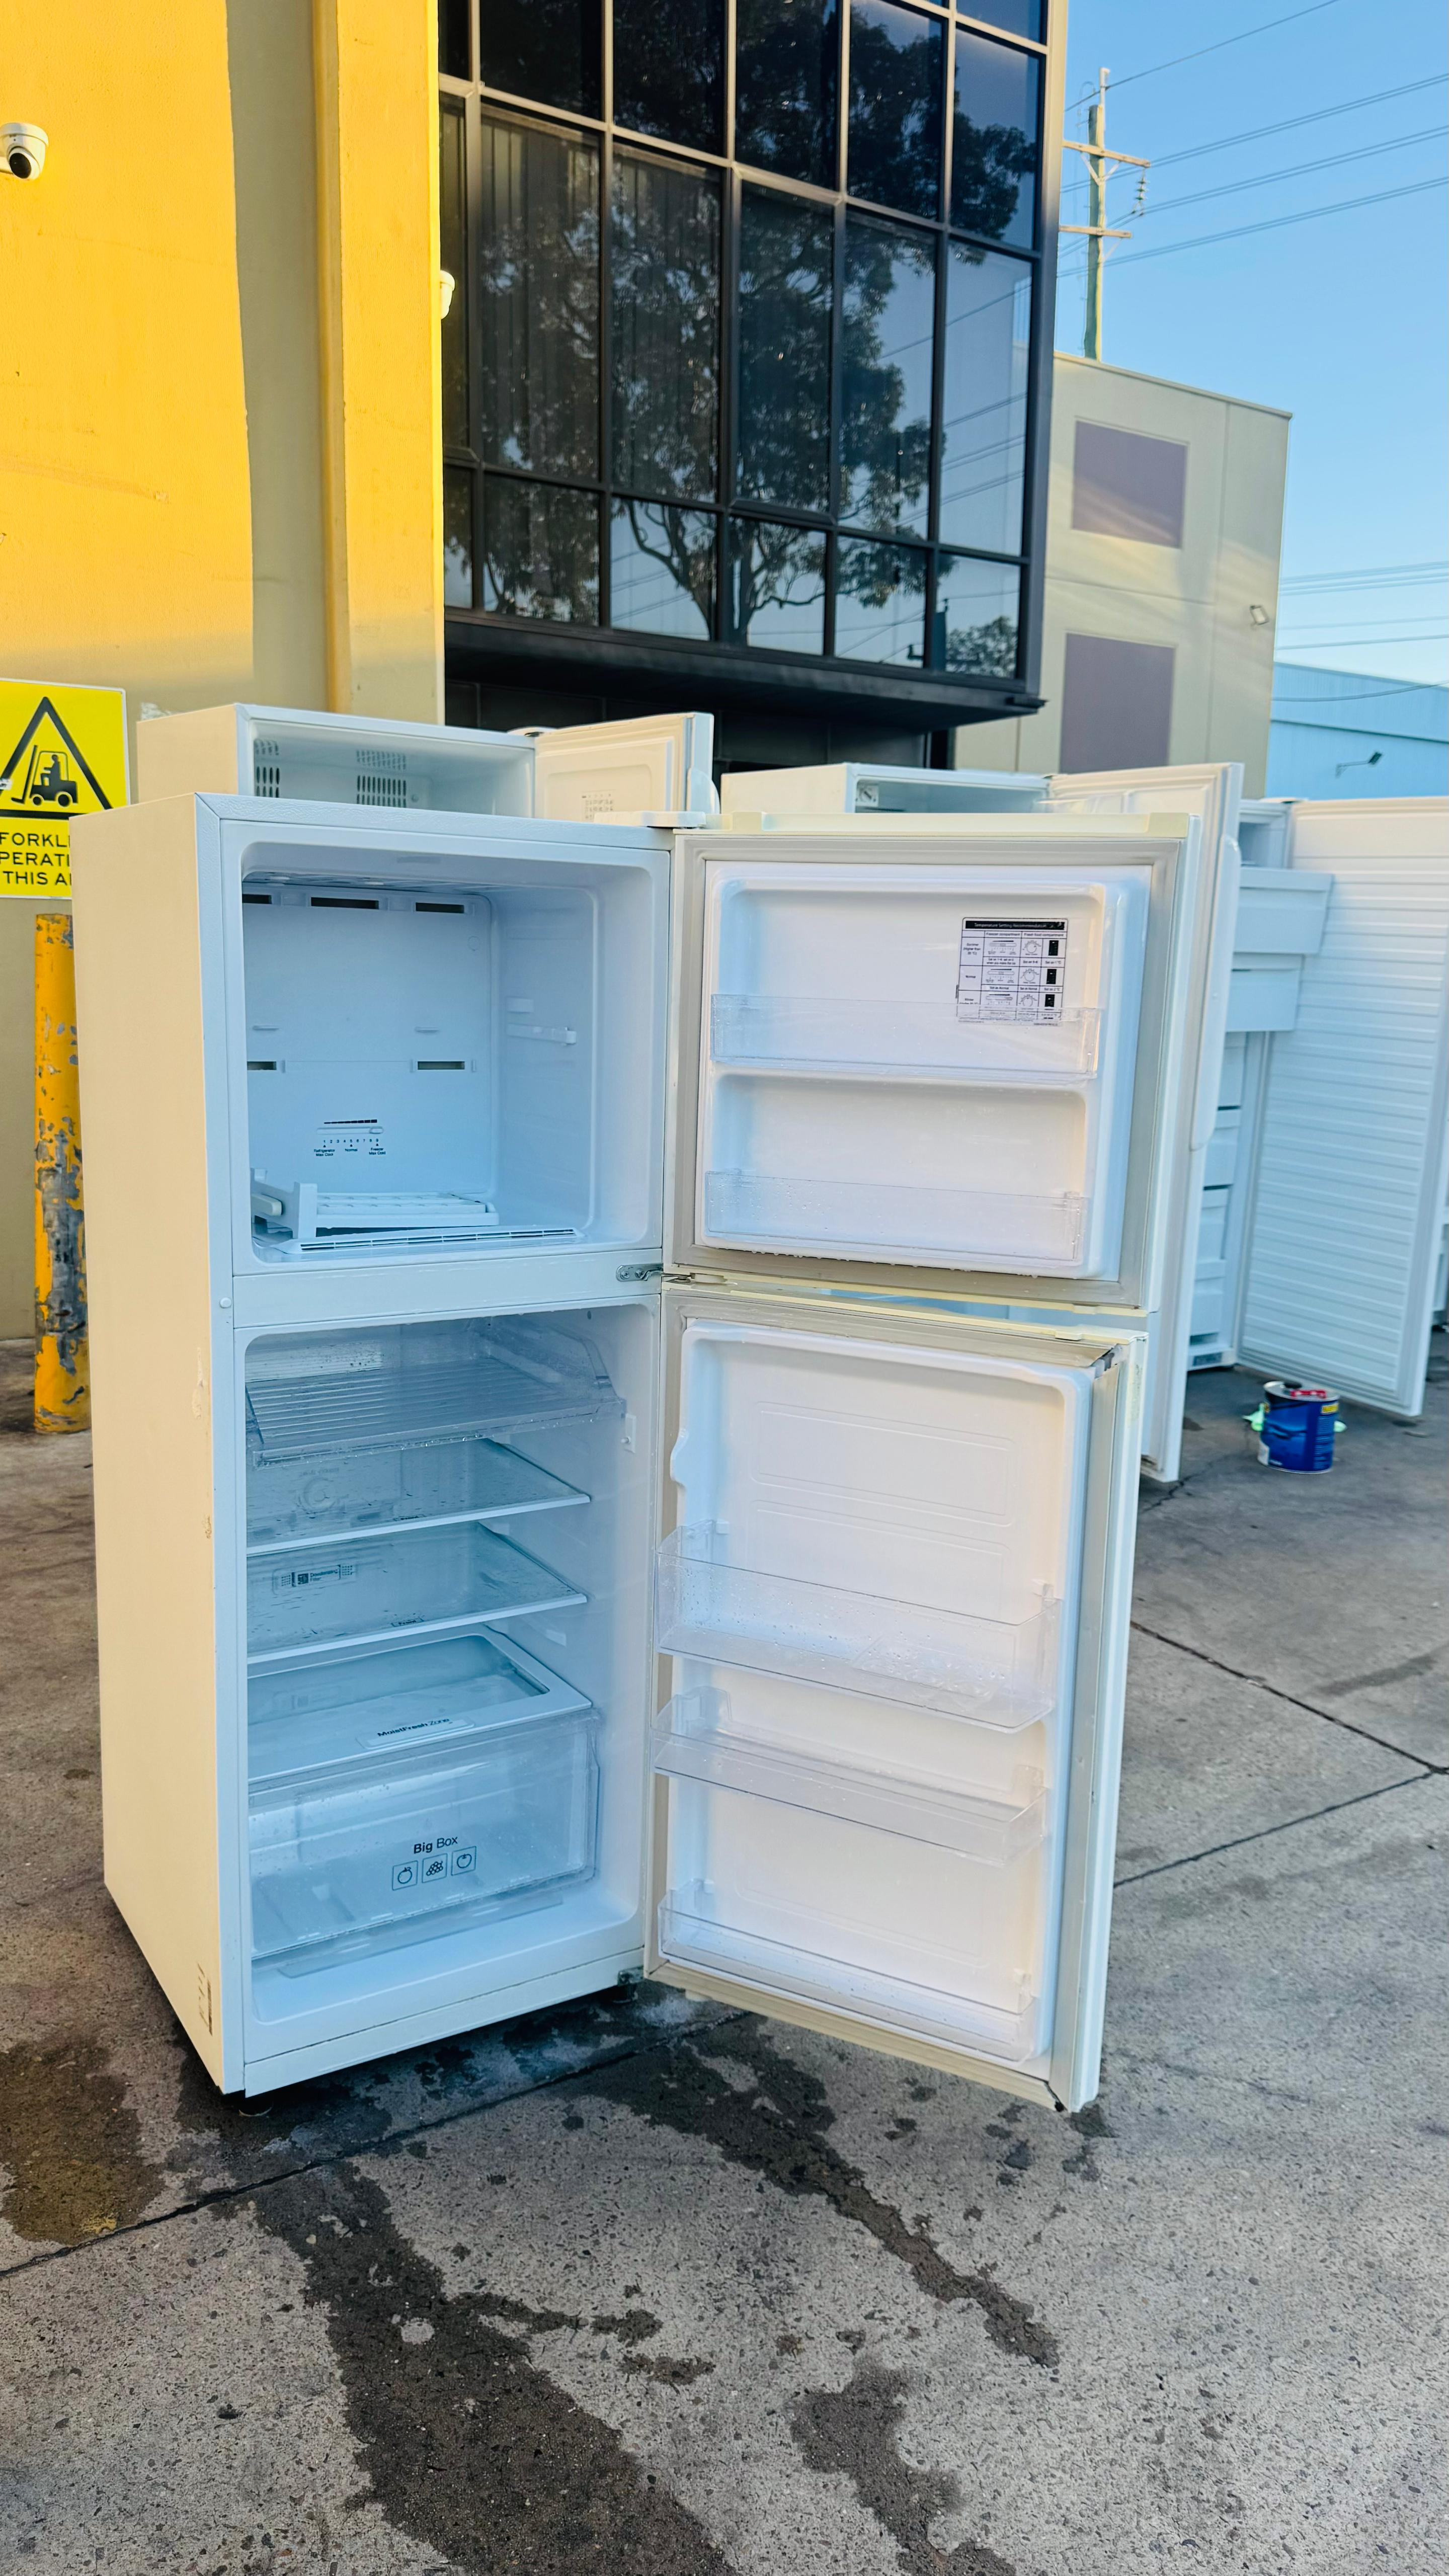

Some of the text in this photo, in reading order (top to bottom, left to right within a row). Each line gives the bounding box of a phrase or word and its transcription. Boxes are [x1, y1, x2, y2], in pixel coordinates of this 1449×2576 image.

[3, 871, 48, 884] THIS
[413, 1836, 458, 1854] Big Box
